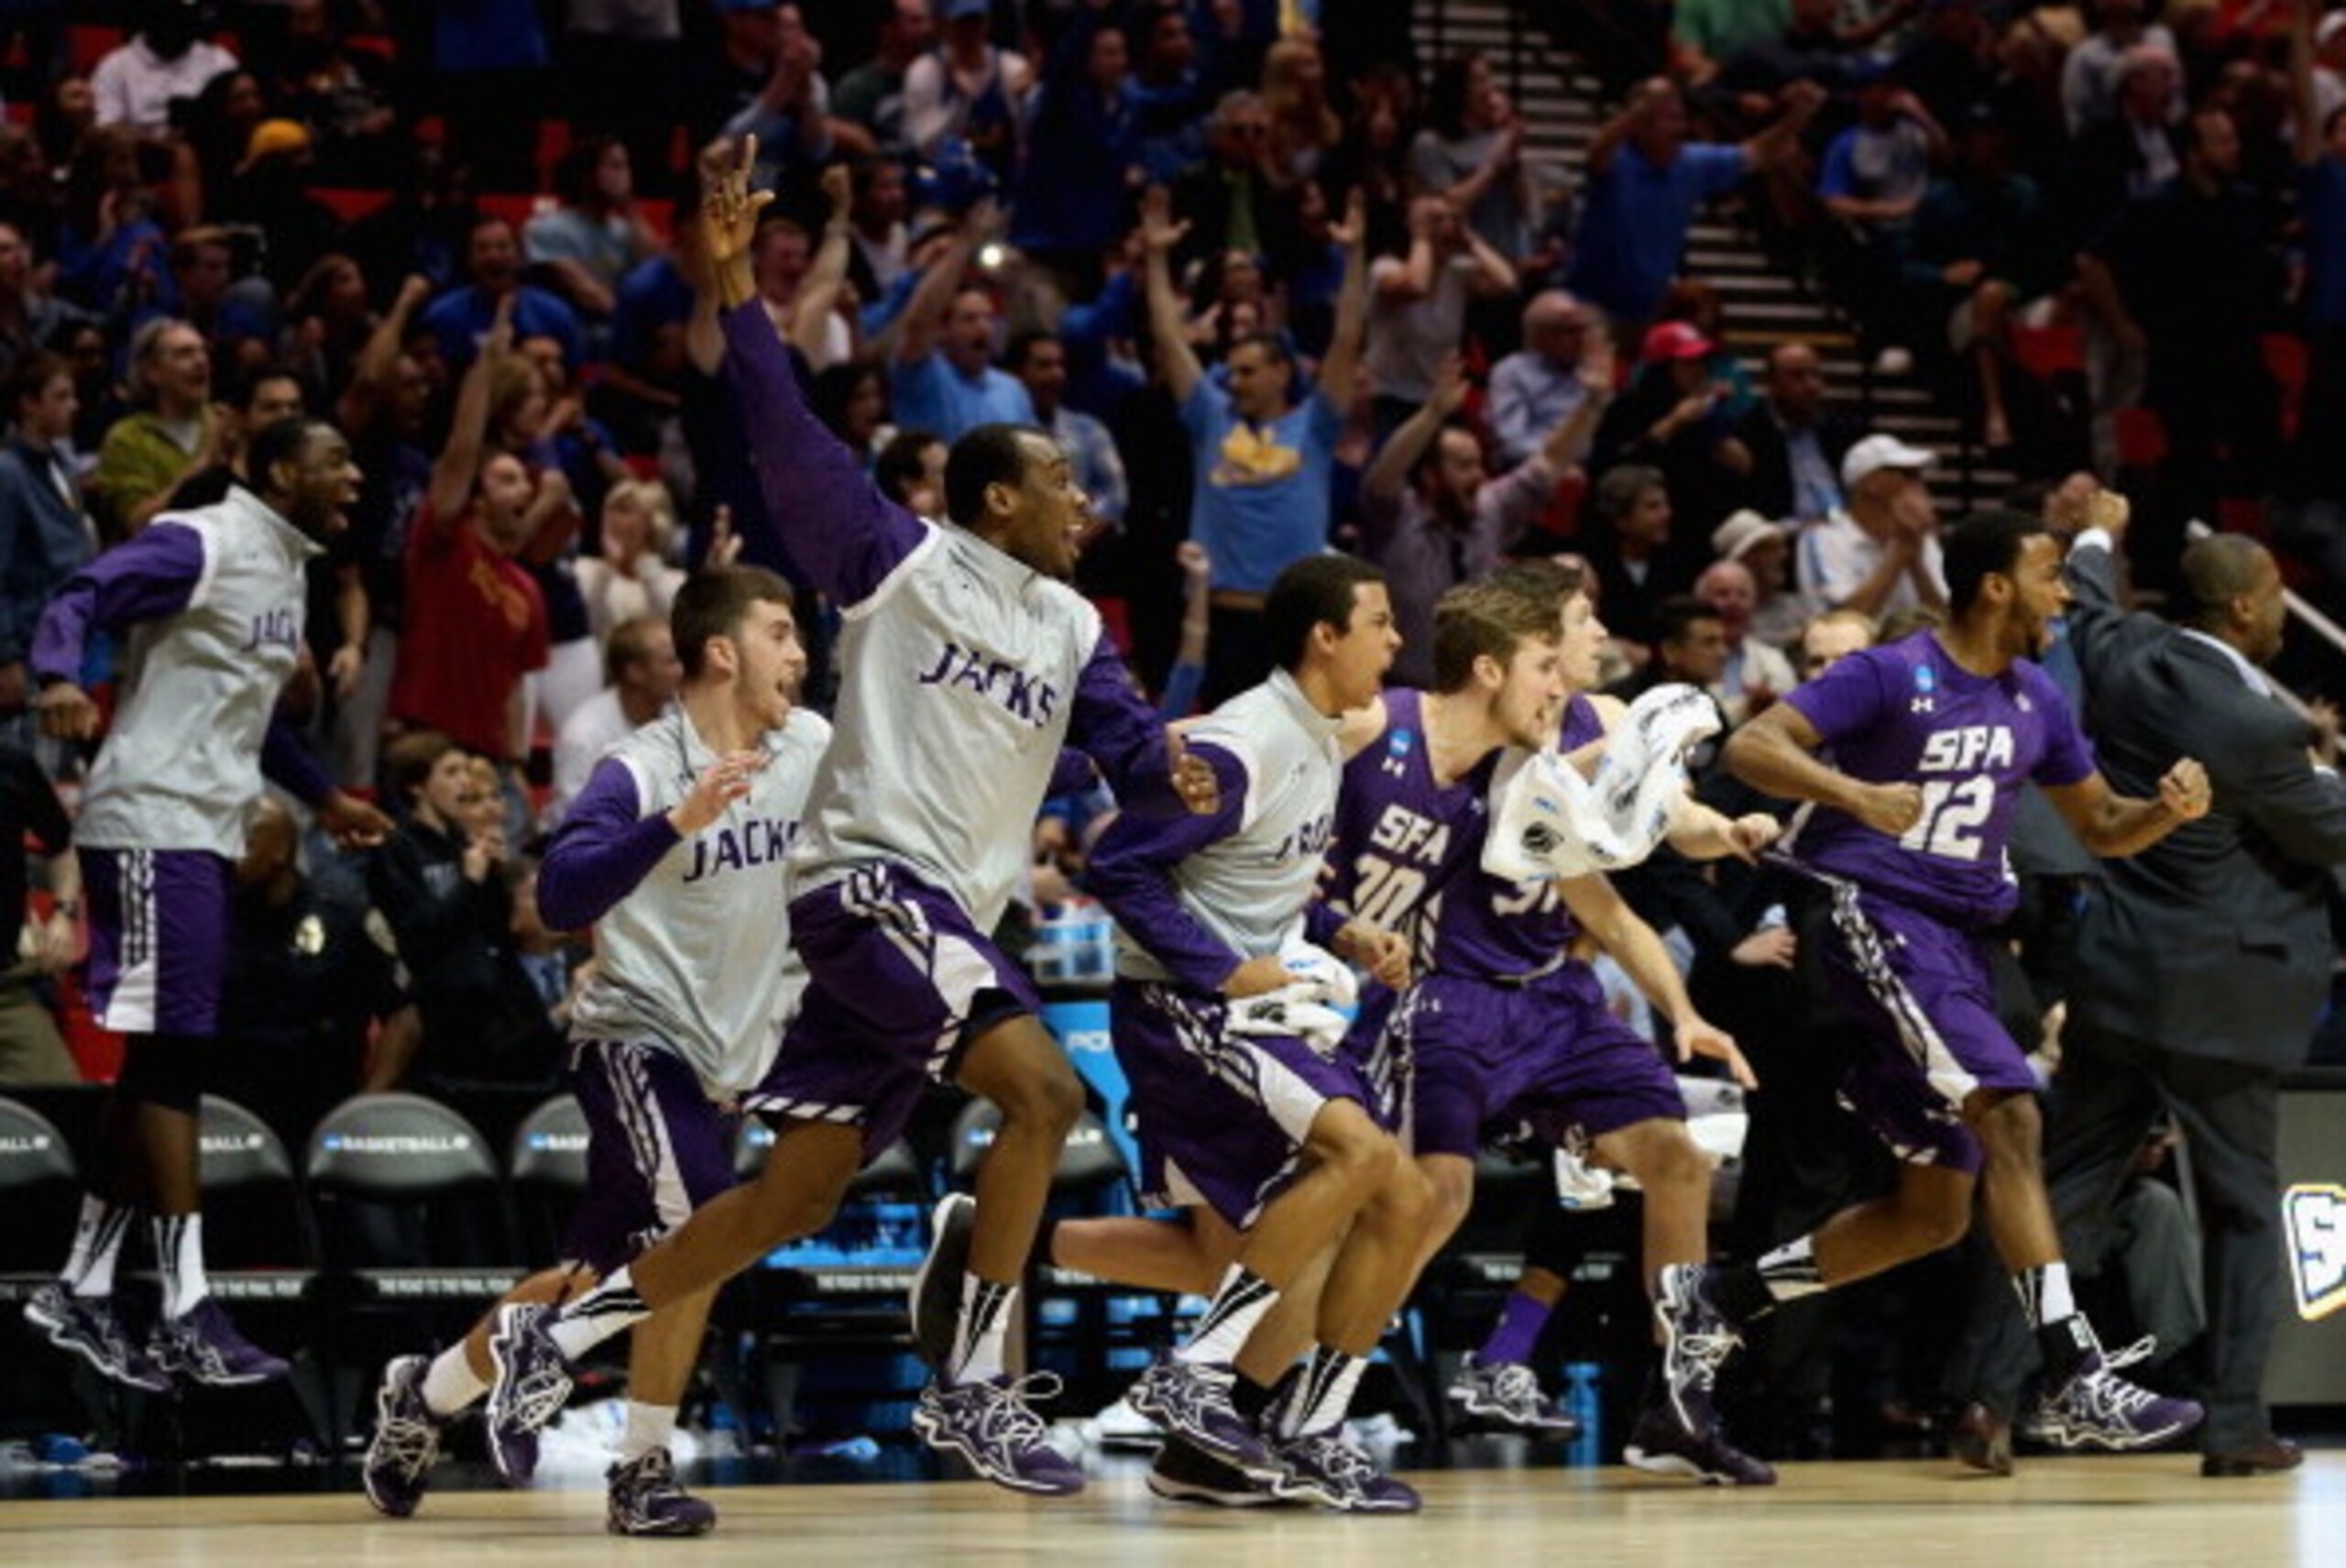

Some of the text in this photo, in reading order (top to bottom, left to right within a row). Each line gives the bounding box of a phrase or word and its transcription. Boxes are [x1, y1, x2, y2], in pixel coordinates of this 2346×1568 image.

[919, 642, 1057, 728] JACKS
[1371, 804, 1450, 865] SFA
[1899, 773, 1995, 860] 12
